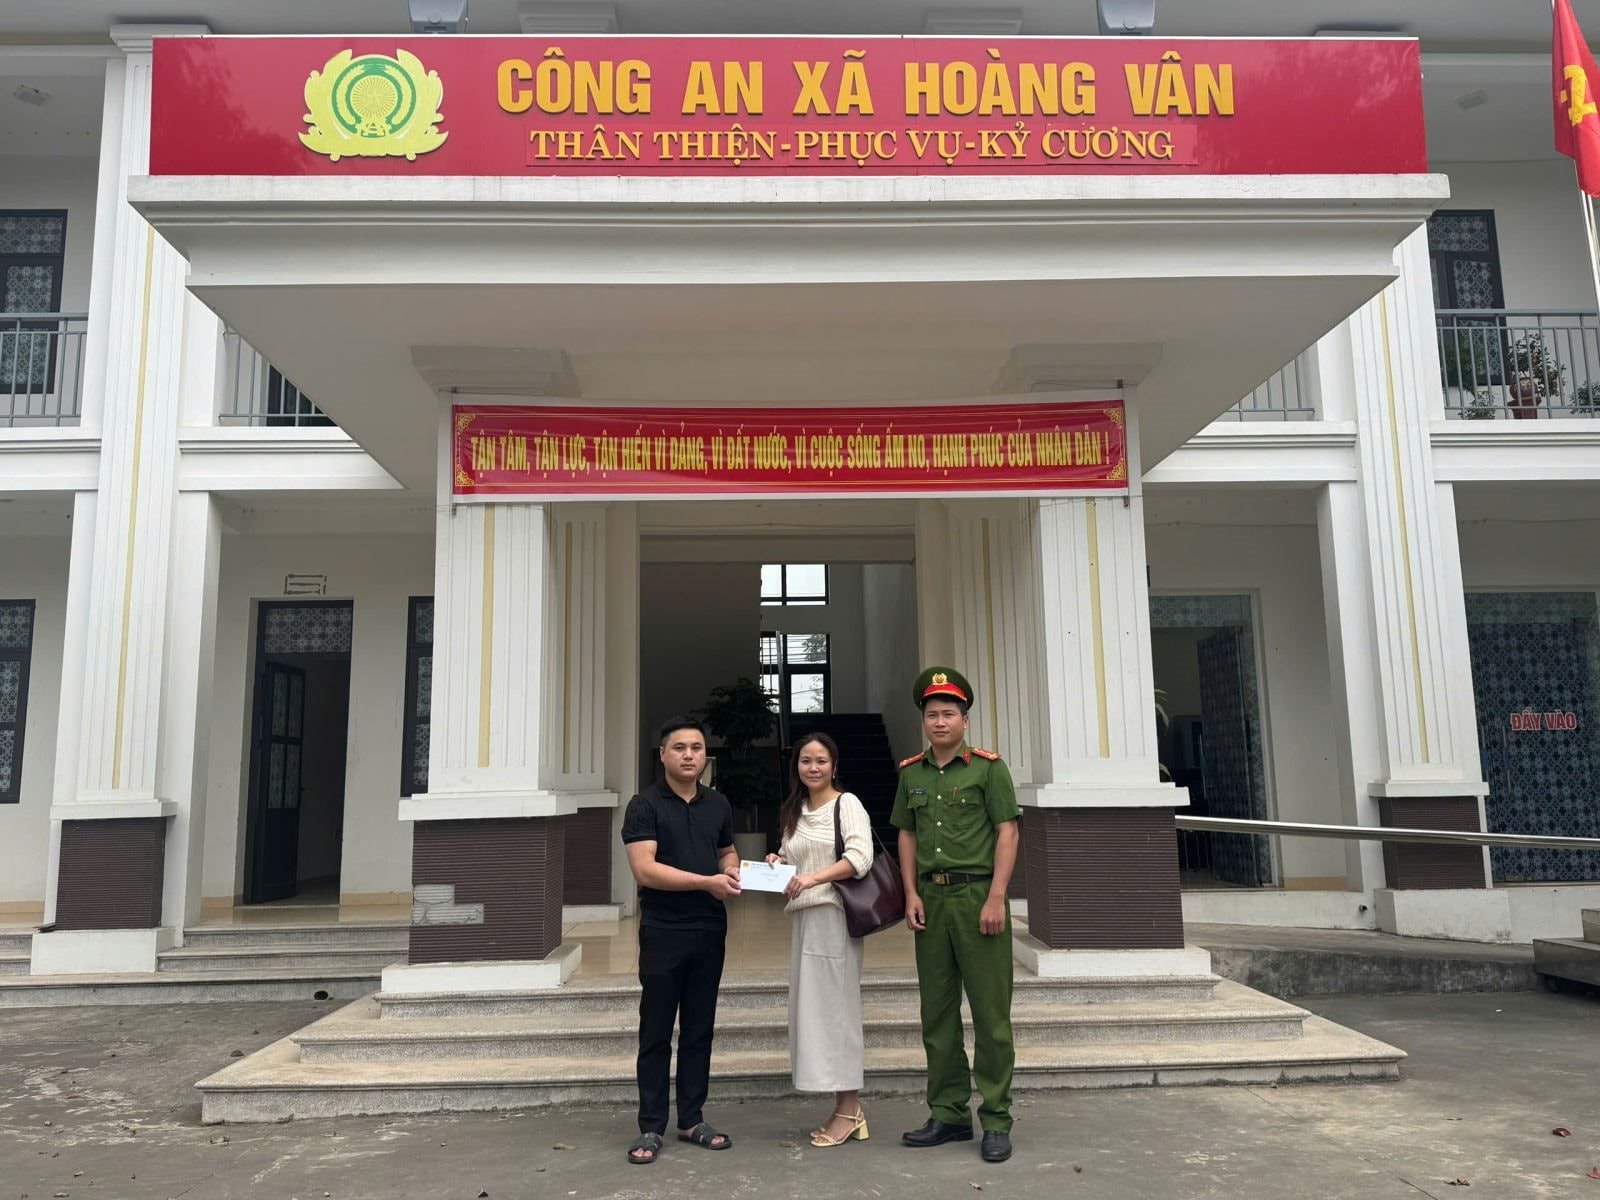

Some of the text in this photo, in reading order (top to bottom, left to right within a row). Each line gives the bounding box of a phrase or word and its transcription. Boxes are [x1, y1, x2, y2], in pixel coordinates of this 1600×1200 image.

[497, 47, 1235, 116] CÔNG AN XÃ HOÀNG VÂN
[529, 121, 1175, 167] THÂN THIỆN-PHỤC VỤ-KỶ CƯƠNG
[471, 429, 496, 478] TẬN
[500, 429, 531, 475] TÂM,
[534, 429, 559, 478] TẬN
[563, 433, 590, 478] LỰC,
[593, 429, 618, 478] TẬN
[622, 424, 651, 471] HIẾN
[655, 429, 666, 471] VÌ
[670, 422, 708, 474] ĐẢNG,
[712, 428, 723, 470] VÌ
[727, 424, 750, 470] ĐẤT
[754, 425, 791, 474] NƯỚC,
[795, 428, 806, 469] VÌ
[810, 428, 843, 477] CUỘC
[847, 423, 881, 469] SỐNG
[884, 423, 904, 468] ẤM
[908, 434, 929, 472] NO,
[933, 434, 967, 476] HẠNH
[971, 426, 1004, 467] PHÚC
[1008, 418, 1033, 467] CỦA
[1036, 425, 1072, 467] NHÂN
[1075, 424, 1101, 465] DÂN
[1510, 707, 1577, 731] ĐẨY VÀO
